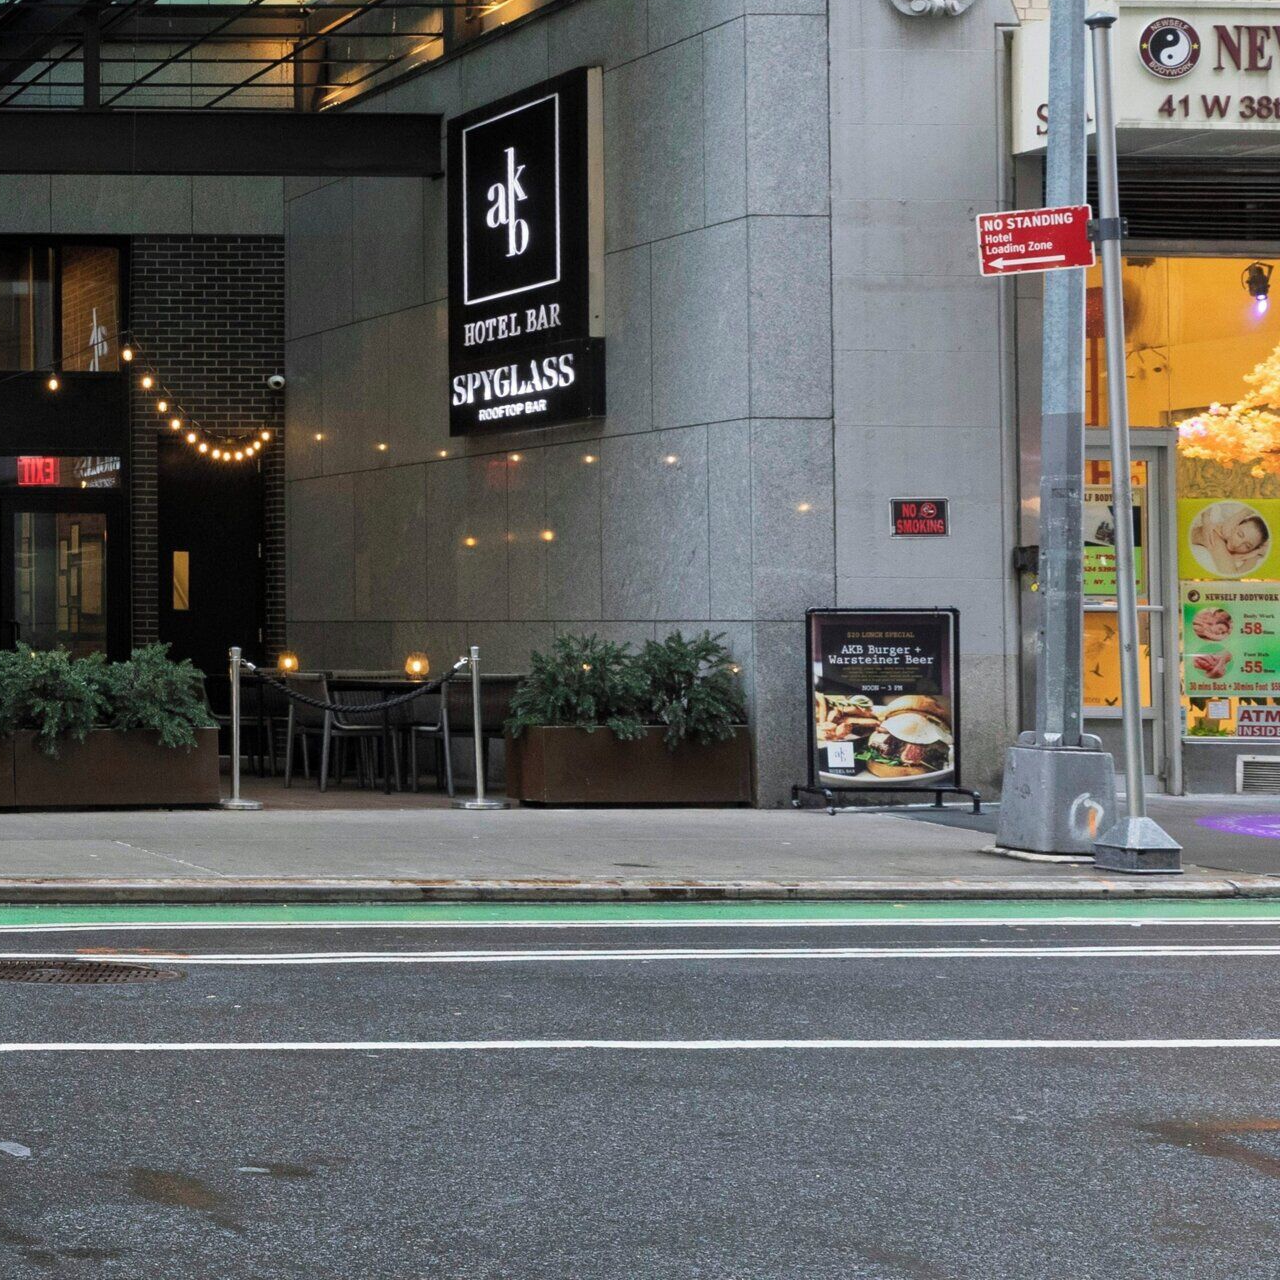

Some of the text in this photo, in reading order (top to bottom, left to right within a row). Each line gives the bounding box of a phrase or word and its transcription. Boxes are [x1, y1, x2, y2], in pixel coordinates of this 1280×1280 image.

[1150, 19, 1190, 32] NEWSELF
[1213, 24, 1280, 71] NE
[1148, 61, 1194, 76] BODYWORK
[1158, 94, 1190, 118] 41
[1200, 94, 1232, 118] W
[984, 212, 1073, 232] NO STANDING
[985, 232, 1012, 244] Hotel
[986, 241, 1053, 255] Loading Zone
[464, 302, 561, 347] HOTEL BAR
[452, 354, 575, 406] SPYGLASS
[478, 398, 547, 421] ROOFTOP BAR
[902, 503, 917, 518] NO
[896, 519, 945, 534] SMOKING
[1205, 593, 1280, 602] NEWSELF BODYWORK
[1240, 622, 1263, 635] $58
[841, 645, 863, 654] AKB
[868, 645, 910, 657] Burger
[828, 655, 934, 665] Warsteiner Beer
[1240, 660, 1263, 673] $55
[1212, 682, 1227, 691] Back
[1240, 710, 1280, 722] ATM
